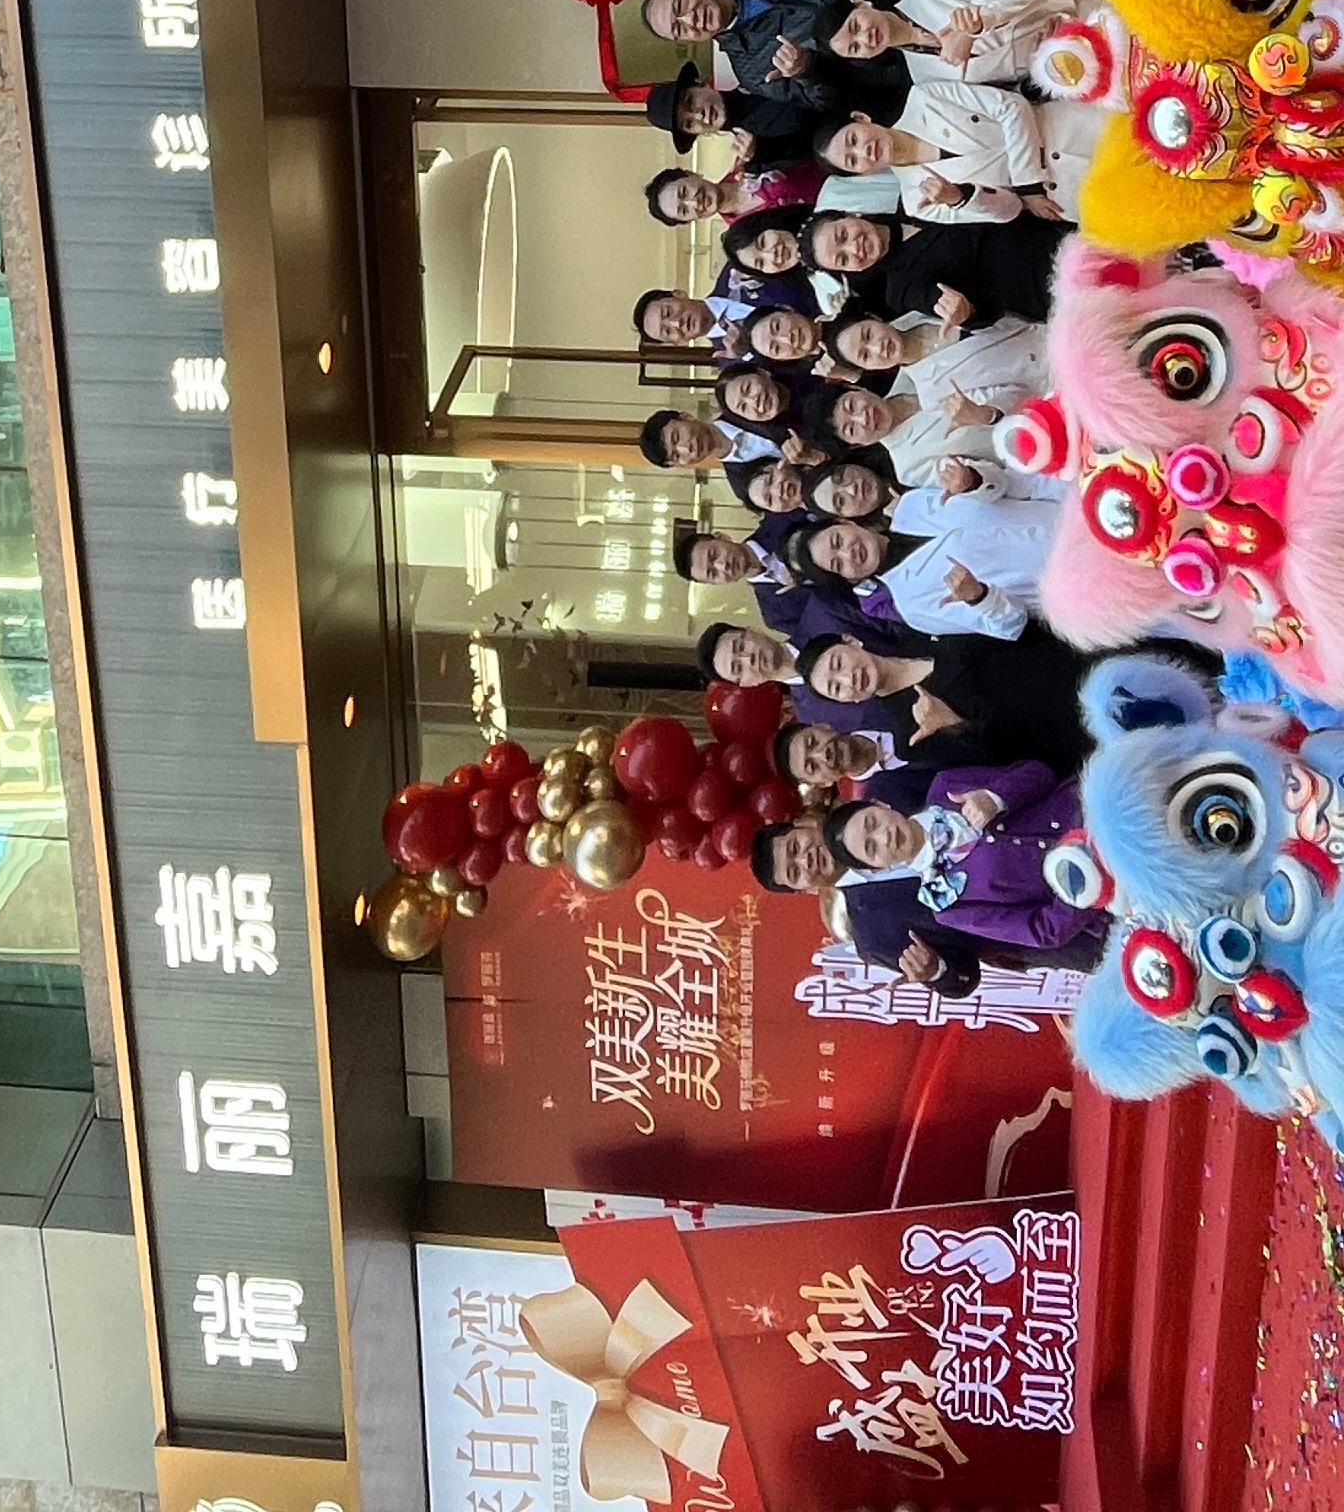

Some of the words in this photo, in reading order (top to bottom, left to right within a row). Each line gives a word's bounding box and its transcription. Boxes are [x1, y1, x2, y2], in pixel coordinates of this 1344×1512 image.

[583, 921, 661, 1134] 双美新生
[636, 888, 730, 1110] 美耀全城
[154, 862, 308, 1372] 瑞丽嘉
[945, 1288, 1014, 1420] 美好
[1013, 1215, 1074, 1424] 如约而至
[665, 1361, 735, 1512] Wome
